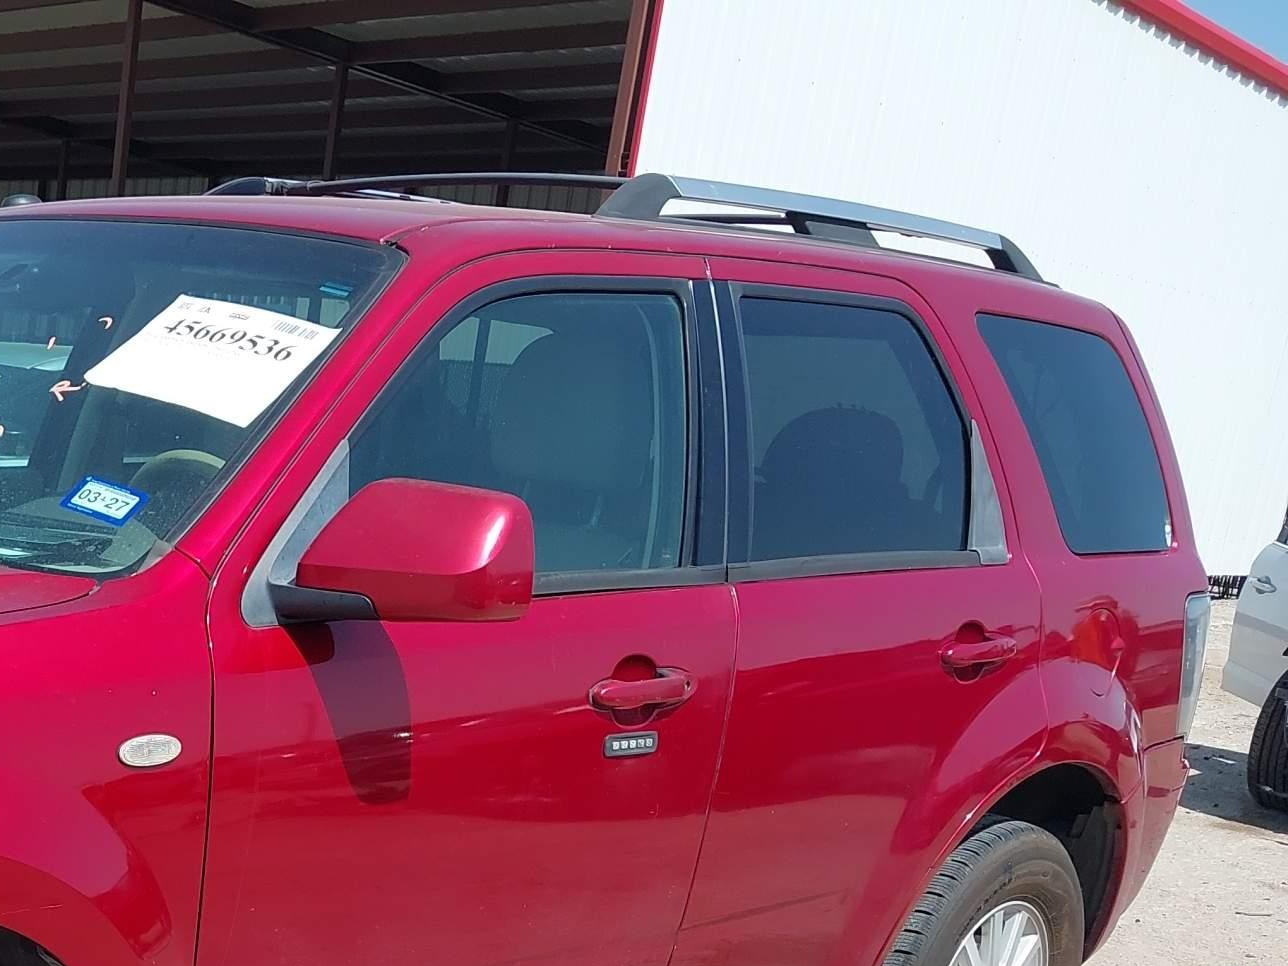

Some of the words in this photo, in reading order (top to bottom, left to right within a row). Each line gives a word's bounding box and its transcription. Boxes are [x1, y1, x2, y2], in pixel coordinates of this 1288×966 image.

[164, 318, 297, 362] 45669536
[78, 488, 102, 503] 03
[104, 497, 131, 512] 27
